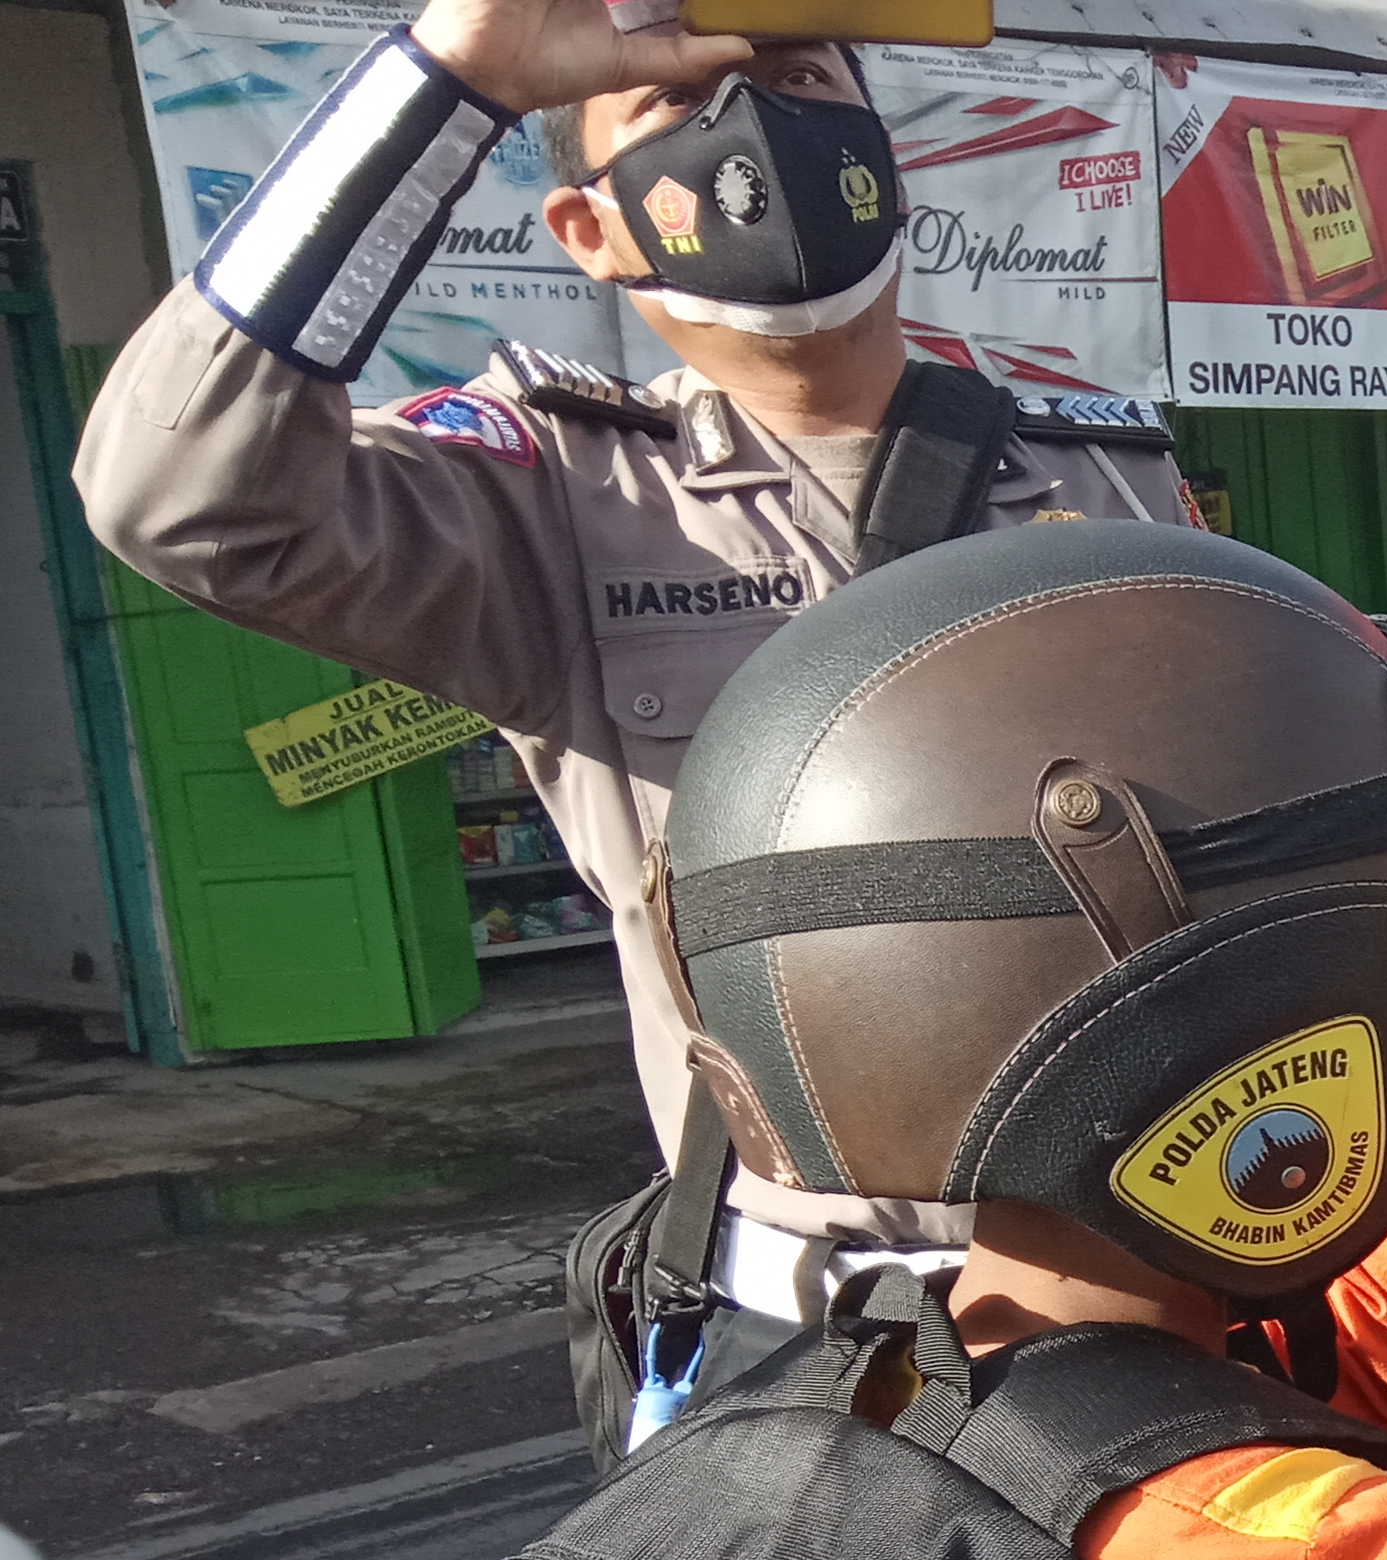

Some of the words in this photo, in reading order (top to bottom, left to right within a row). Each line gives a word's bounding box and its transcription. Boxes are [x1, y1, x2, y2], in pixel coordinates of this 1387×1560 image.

[1162, 104, 1205, 165] NEW
[1072, 157, 1137, 184] CHOOSE
[1090, 183, 1133, 211] LIVE!
[661, 235, 703, 255] TNI
[1313, 220, 1357, 241] FILTER
[911, 204, 1109, 292] Diplomat
[414, 283, 457, 298] ILD
[471, 282, 598, 300] MENTHOL
[1058, 286, 1106, 300] MILD
[1266, 313, 1353, 347] TOKO
[1188, 361, 1341, 396] SIMPANG
[605, 571, 804, 618] HARSENO
[329, 682, 403, 720] JUAL
[264, 715, 384, 777] MINYAK
[382, 692, 456, 734] KEM
[300, 766, 385, 798] MENCEGAH
[1148, 1096, 1238, 1186] POLDA
[1240, 1047, 1349, 1109] JATENG
[1209, 1216, 1286, 1245] BHABIN
[1291, 1130, 1370, 1237] KAMTIBMAS
